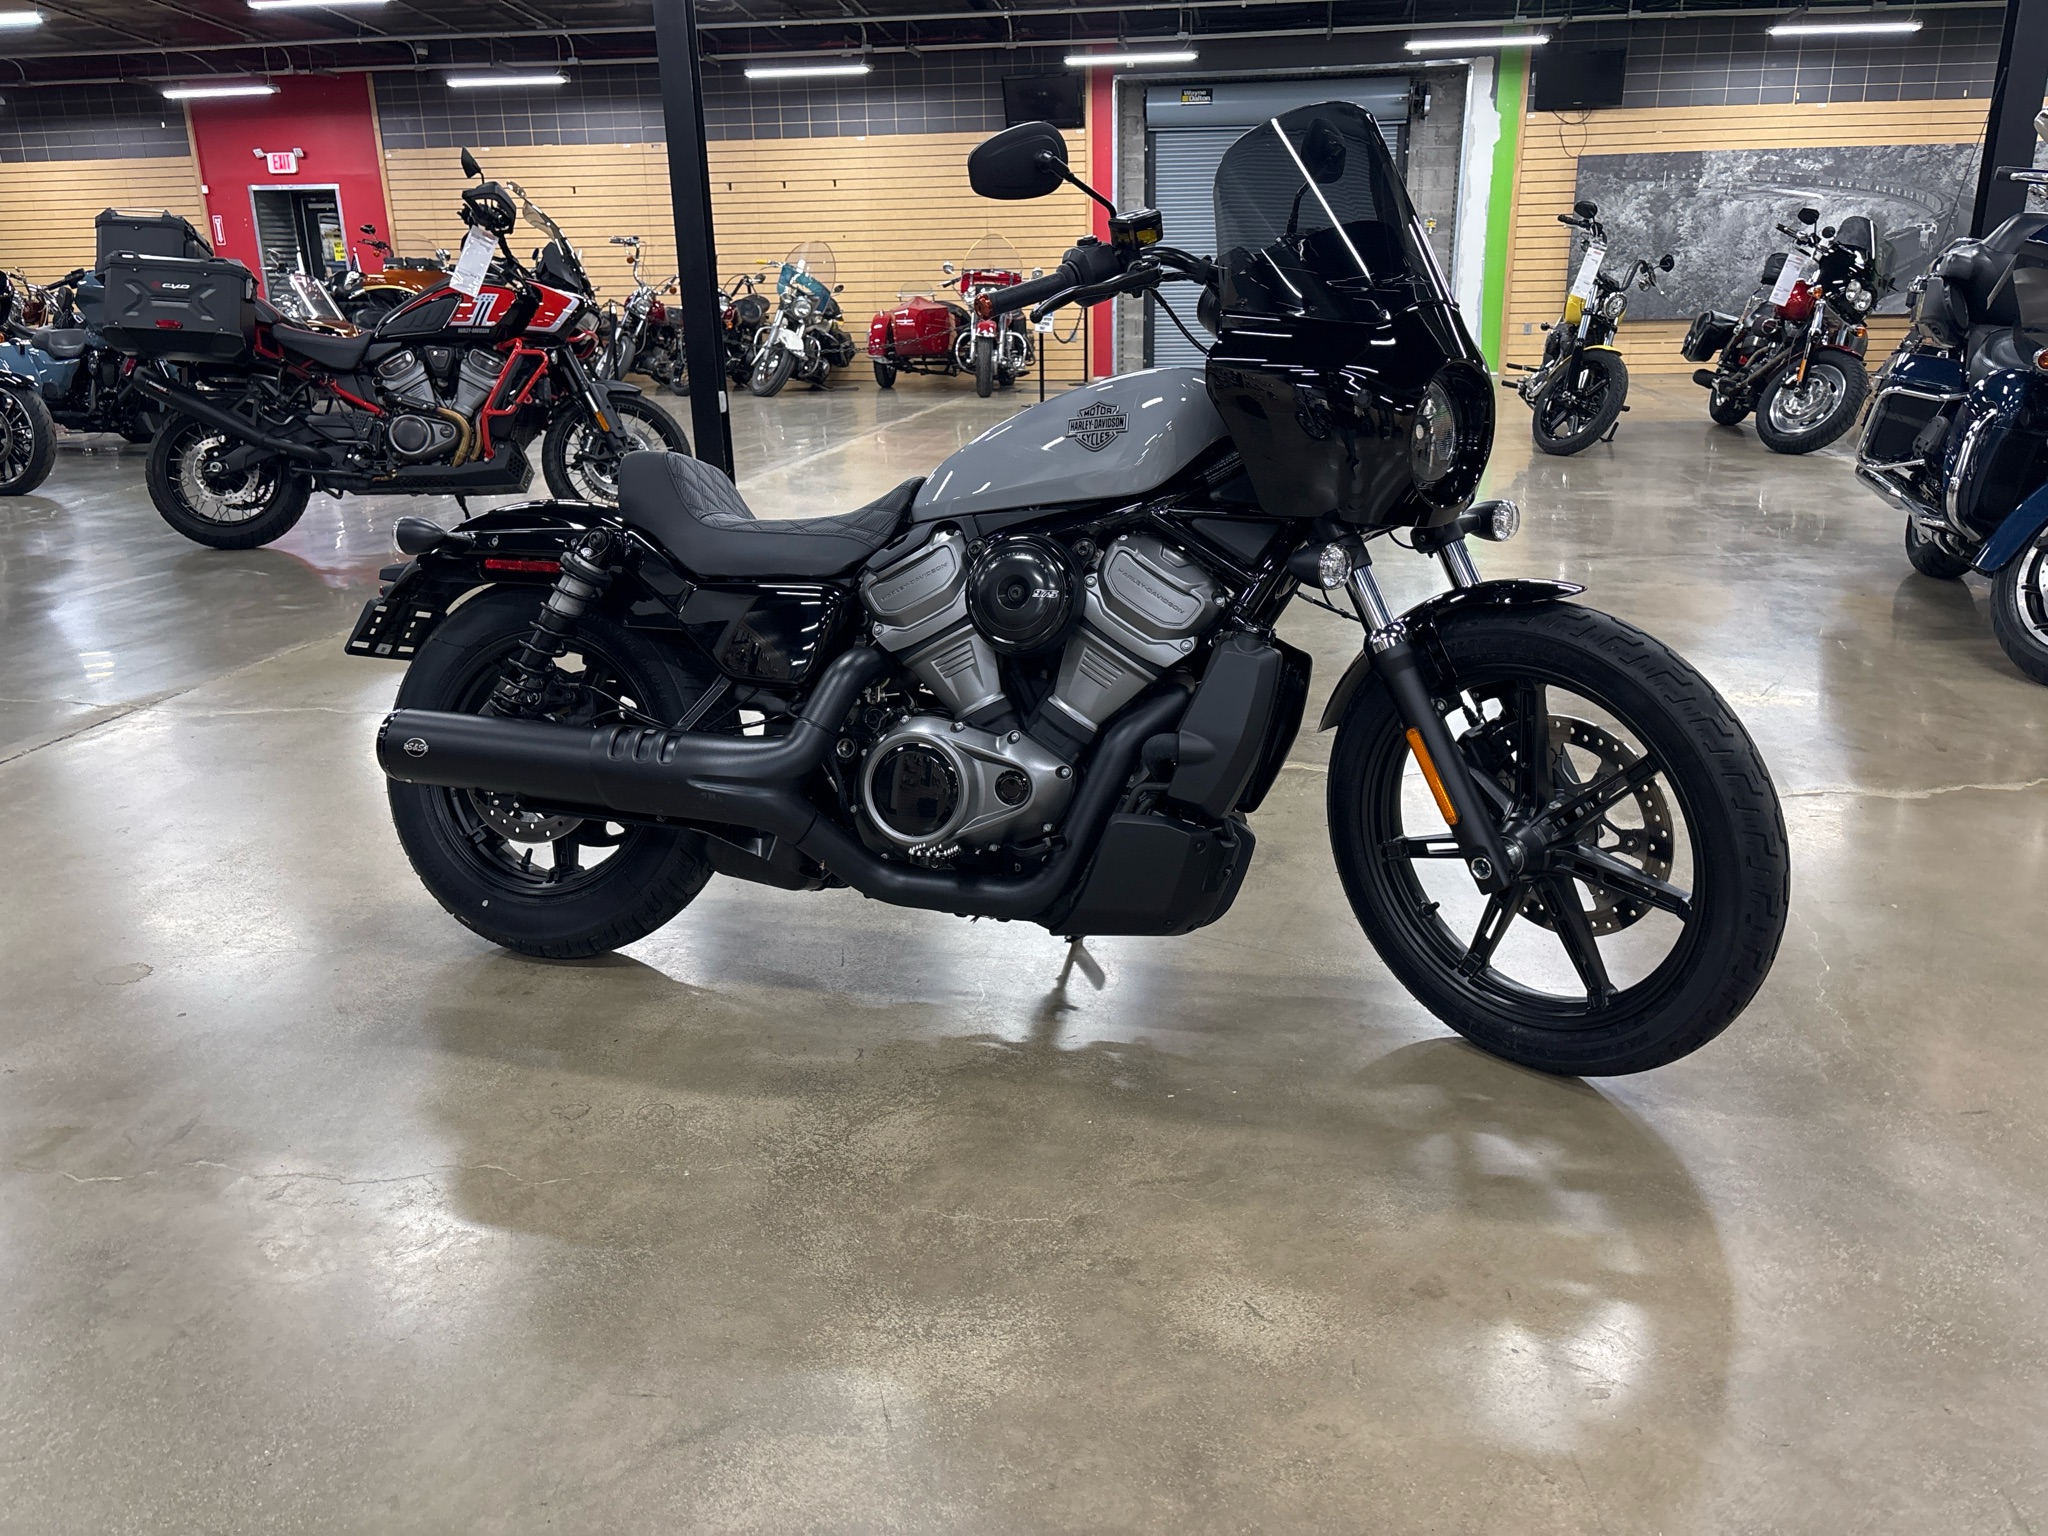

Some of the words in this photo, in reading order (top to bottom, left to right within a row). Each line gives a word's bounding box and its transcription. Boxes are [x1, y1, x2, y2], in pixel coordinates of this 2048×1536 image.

[272, 154, 291, 170] EXIT
[1083, 404, 1113, 417] MOTOR
[1070, 416, 1125, 432] HARLEY-DAVIDSON
[1081, 431, 1111, 446] CYCLES
[881, 562, 948, 602] HARLEY-DAVIDSON
[1032, 588, 1059, 598] 975
[1117, 568, 1185, 614] HARLEY-DAVIDSON
